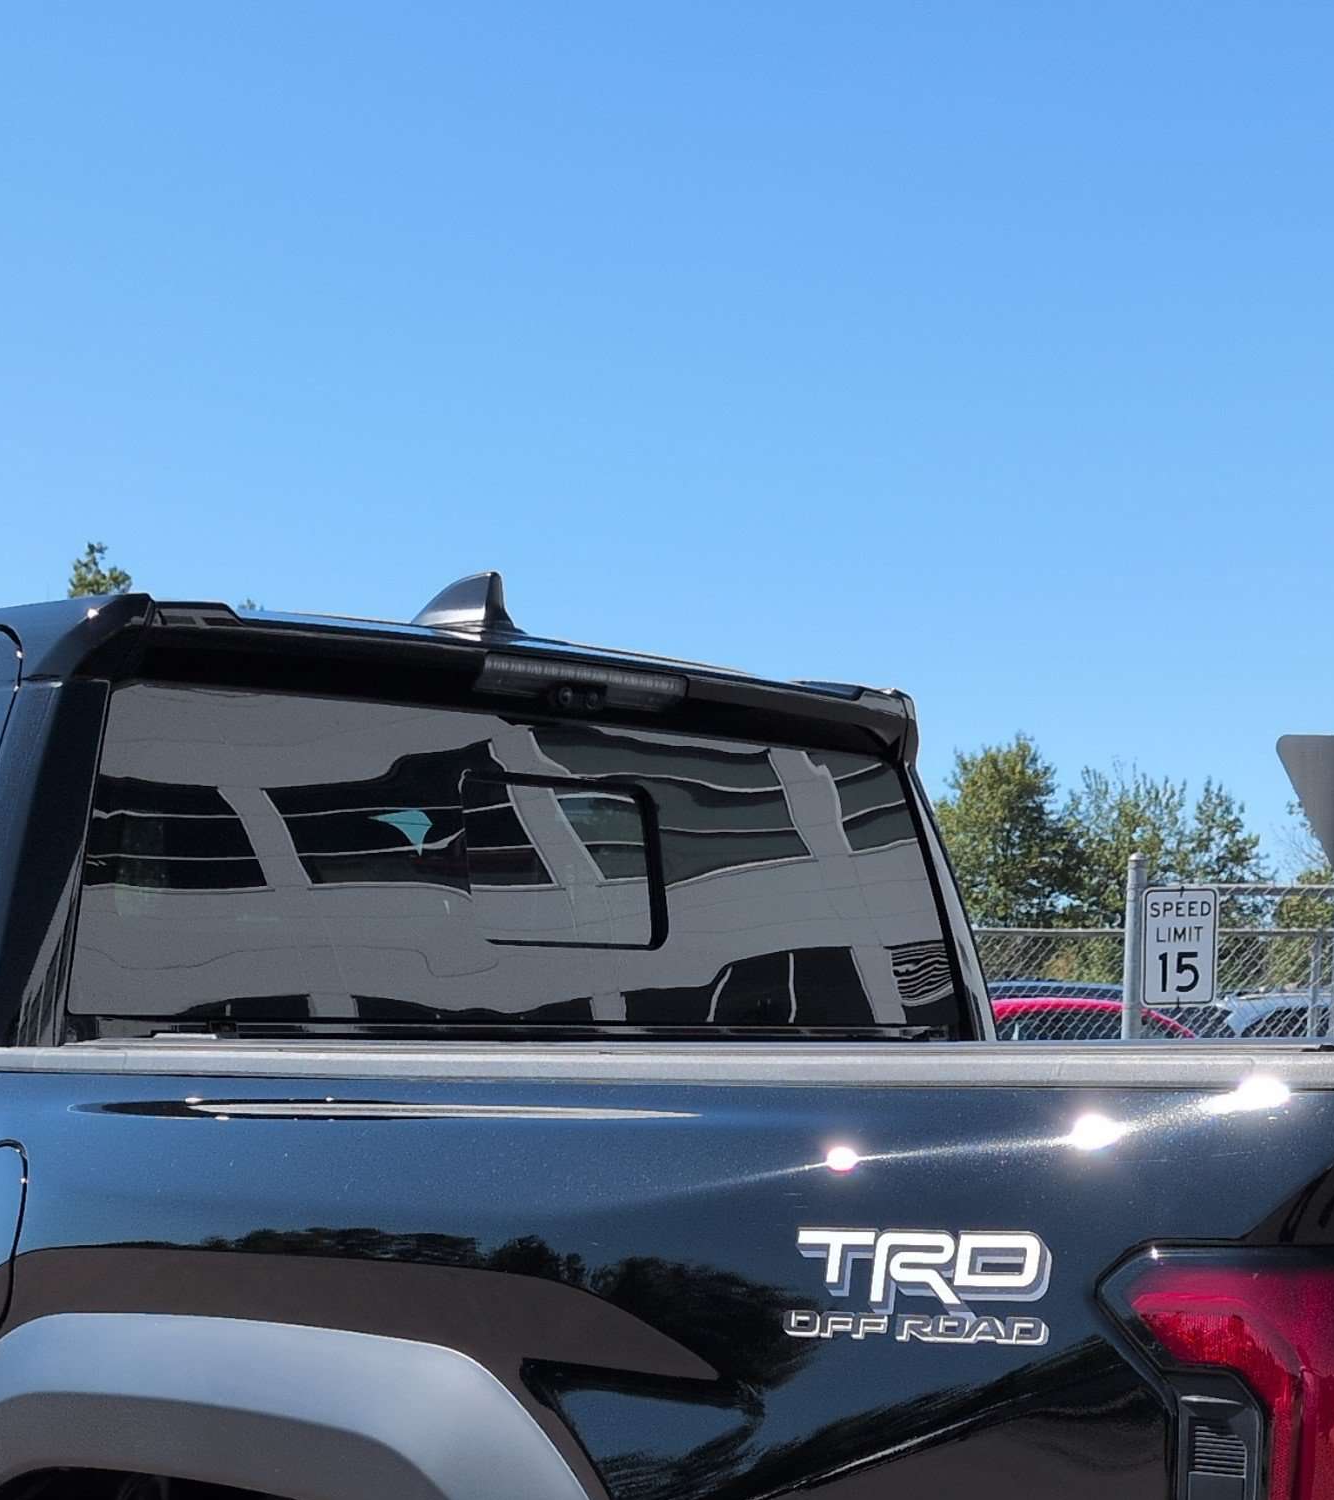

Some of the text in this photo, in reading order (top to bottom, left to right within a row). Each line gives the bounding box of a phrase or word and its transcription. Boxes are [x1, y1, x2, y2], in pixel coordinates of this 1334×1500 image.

[1150, 901, 1212, 918] SPEED
[1156, 926, 1204, 943] LIMIT
[1158, 951, 1200, 993] 15
[795, 1227, 1053, 1320] TRD
[782, 1309, 1050, 1346] OFF ROAD
